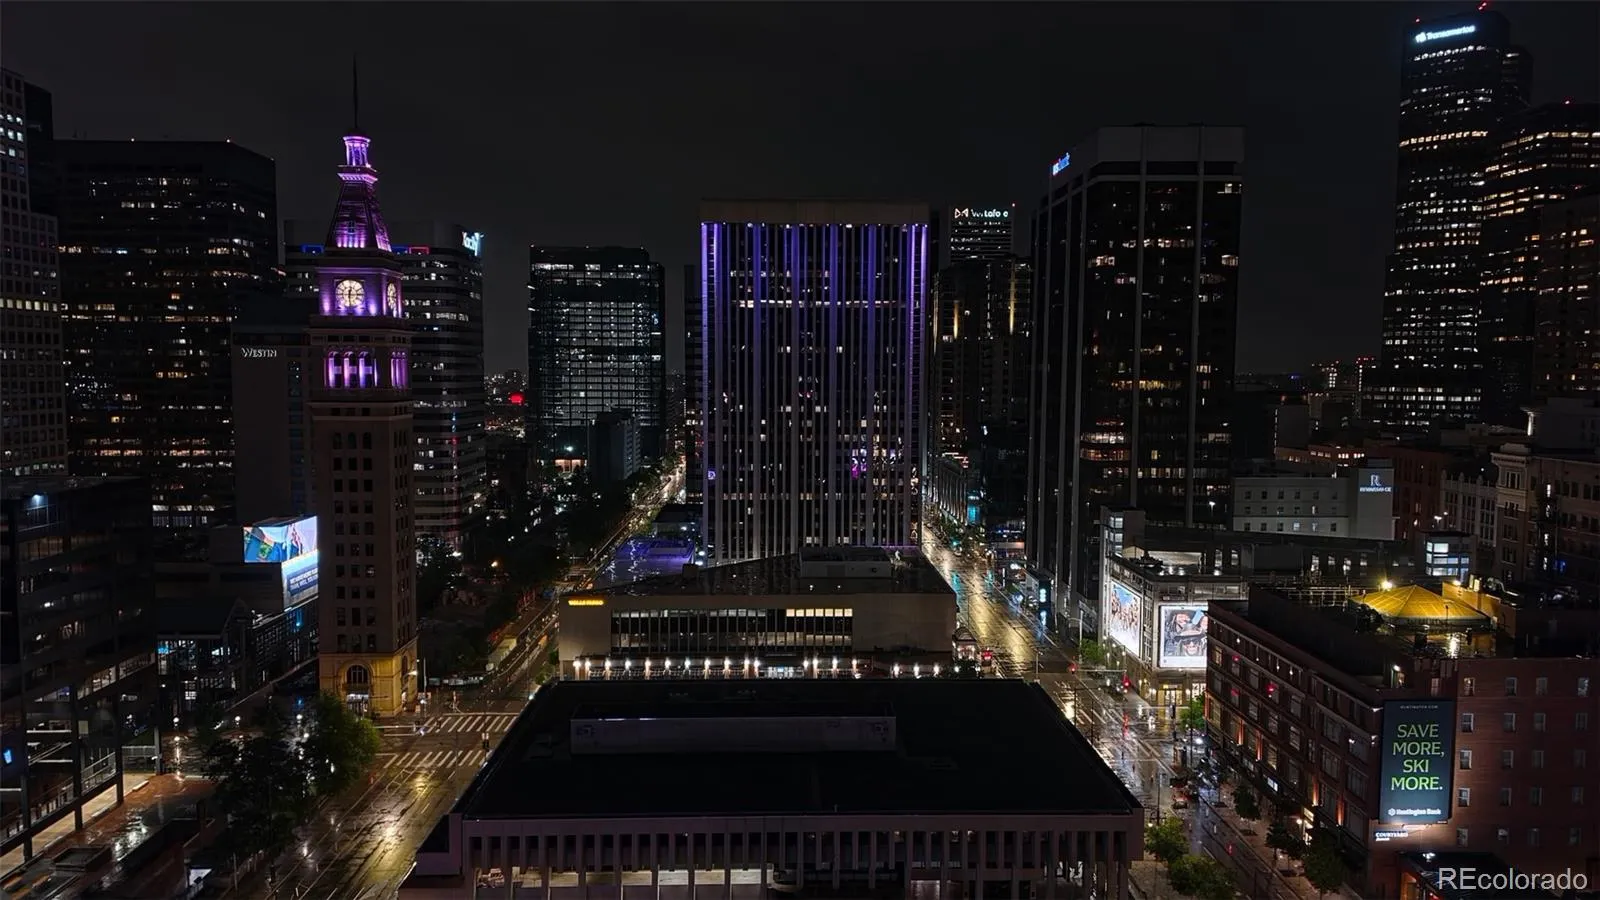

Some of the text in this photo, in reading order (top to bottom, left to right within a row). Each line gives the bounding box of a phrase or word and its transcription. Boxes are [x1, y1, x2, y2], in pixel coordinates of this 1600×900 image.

[241, 347, 277, 358] WESTIN
[1397, 724, 1439, 738] SAVE
[1392, 742, 1445, 757] MORE,
[1403, 759, 1429, 773] SKI
[1391, 776, 1443, 790] MORE.
